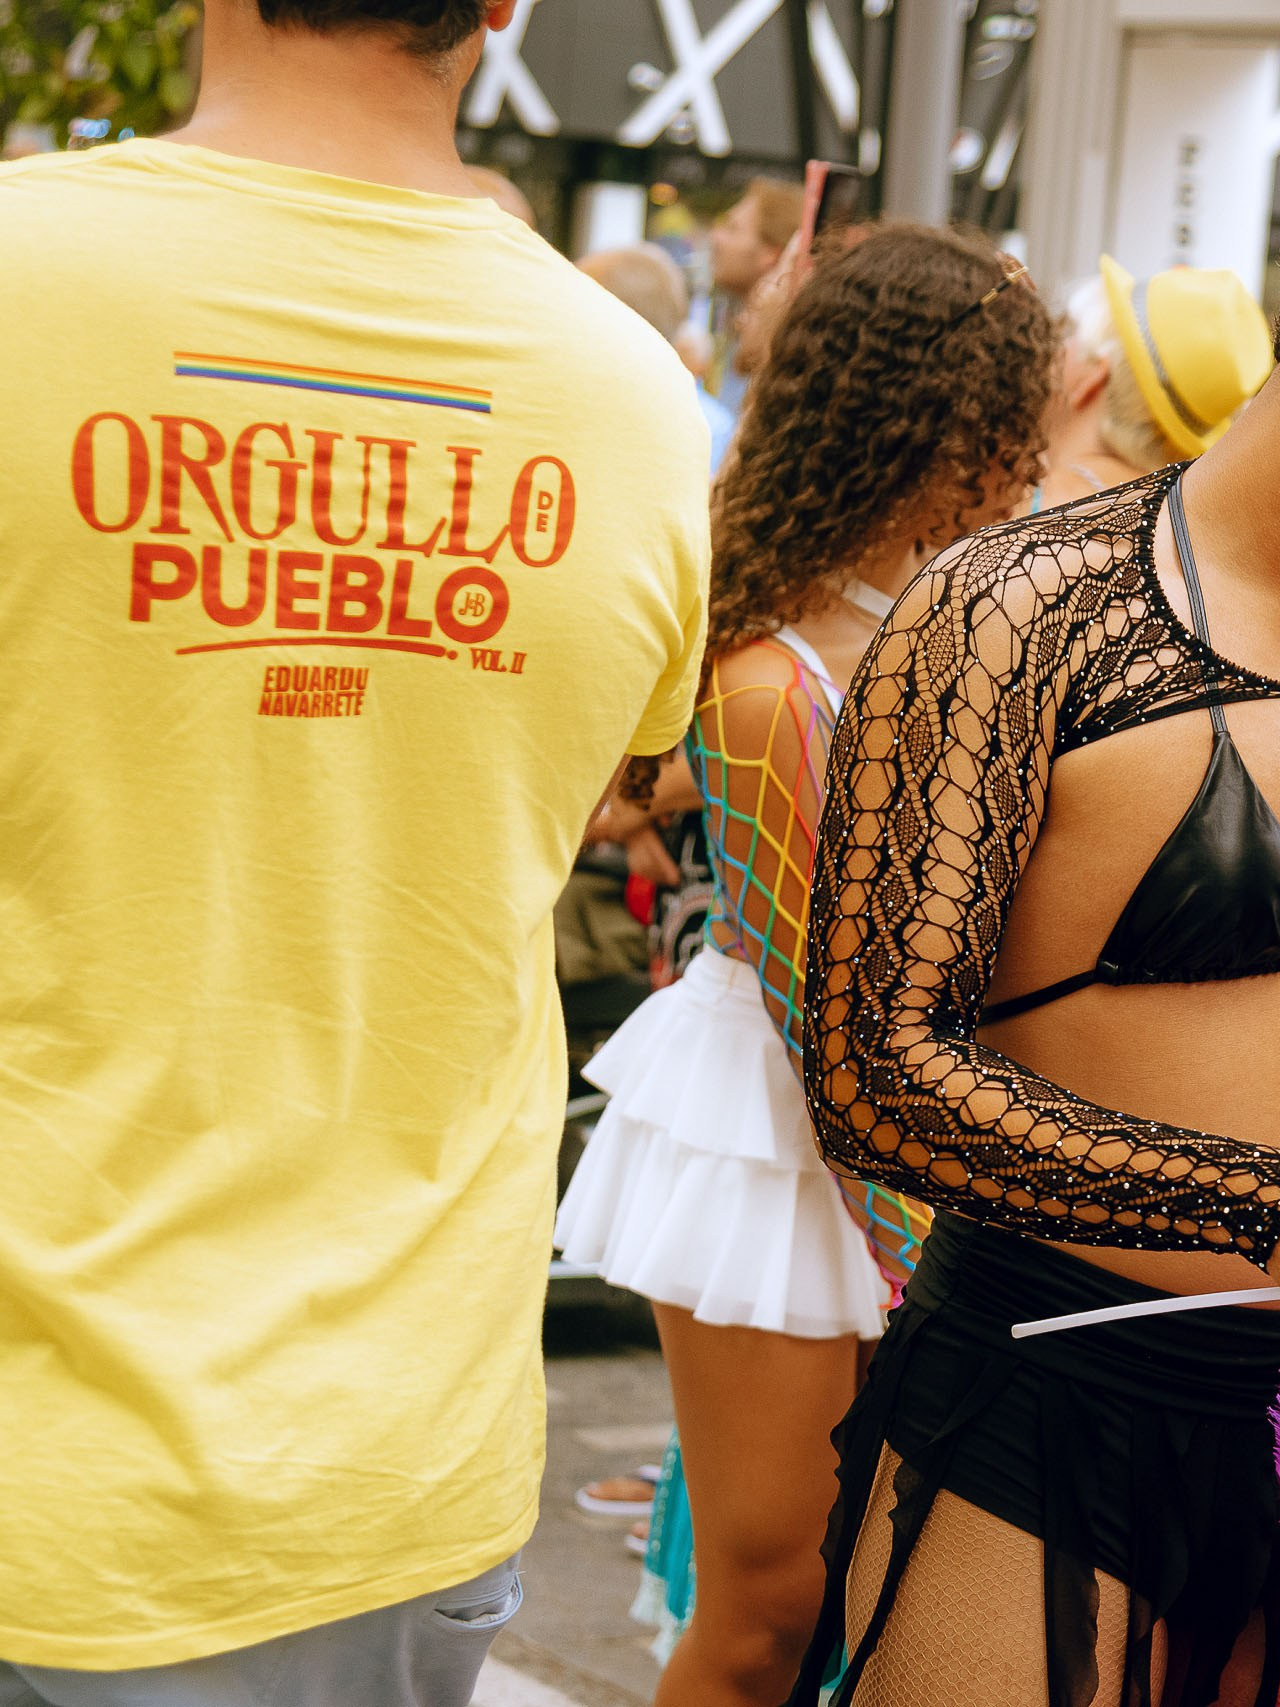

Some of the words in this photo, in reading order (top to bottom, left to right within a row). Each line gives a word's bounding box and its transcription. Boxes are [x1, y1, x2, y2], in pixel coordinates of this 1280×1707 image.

[71, 411, 576, 568] ORGULLO
[536, 490, 554, 533] DE
[130, 542, 510, 644] PUEBLO
[509, 651, 527, 674] II
[257, 690, 365, 718] NAVARRETE
